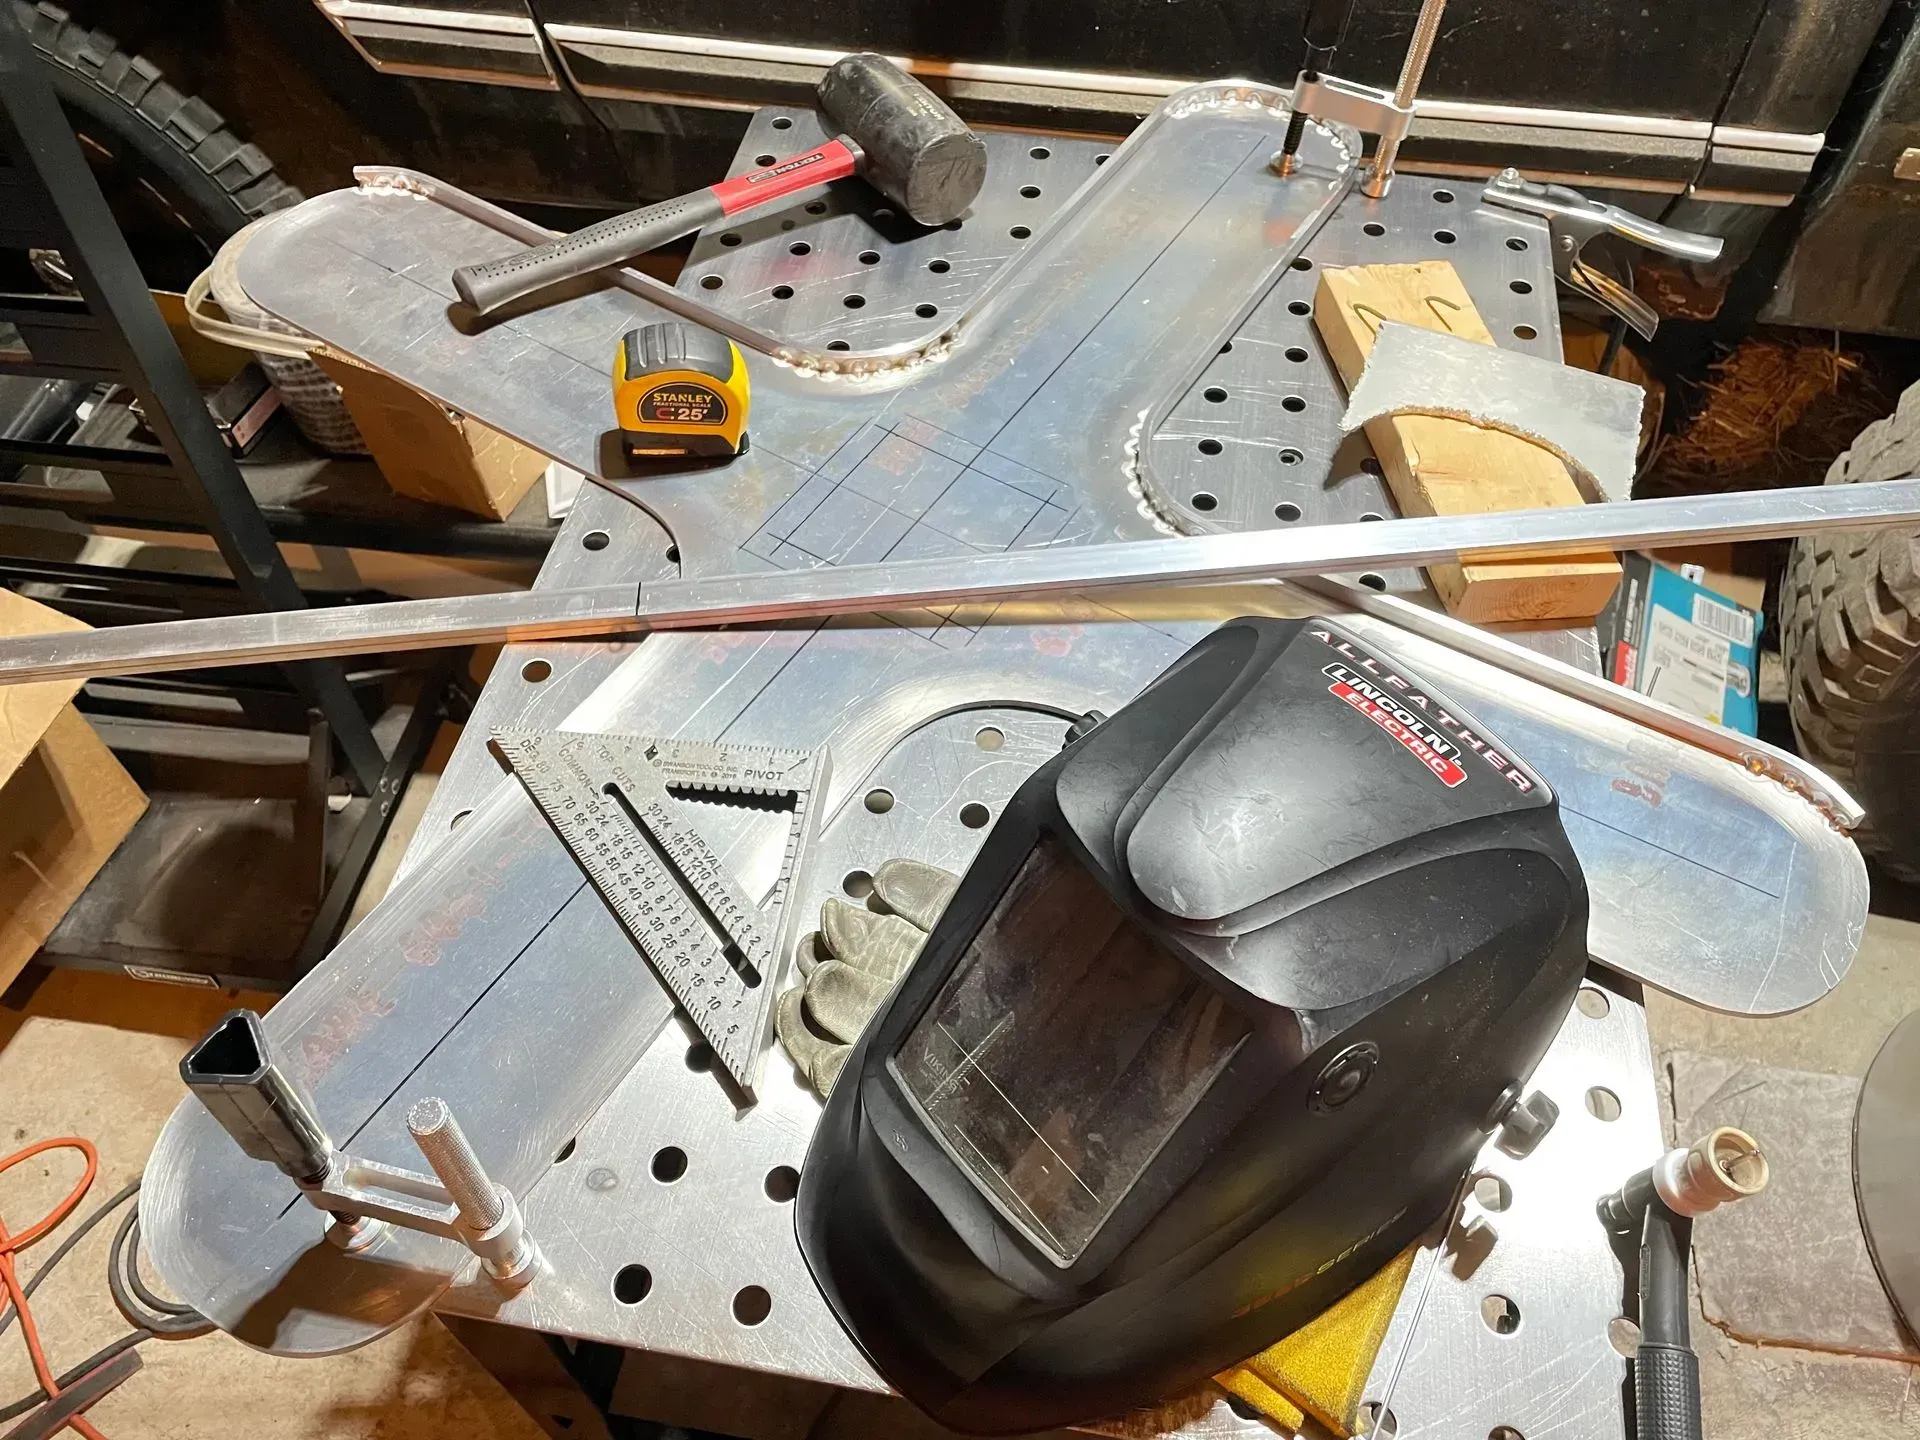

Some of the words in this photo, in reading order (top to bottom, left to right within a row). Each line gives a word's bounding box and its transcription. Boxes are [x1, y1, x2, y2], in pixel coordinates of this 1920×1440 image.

[653, 393, 712, 403] STANLEY
[678, 408, 708, 420] 25'
[1310, 629, 1538, 793] ALLFATHER
[1331, 668, 1452, 756] LINCOLN
[1344, 692, 1448, 773] ELECTRIC
[719, 753, 728, 762] 2
[558, 748, 592, 788] COMMON
[596, 744, 614, 762] TOP
[612, 766, 636, 792] CUTS
[744, 769, 784, 781] PIVOT
[648, 803, 663, 816] 30
[657, 815, 672, 829] 24
[671, 832, 685, 846] 18
[681, 843, 694, 856] 15
[684, 828, 722, 875] HIP-VAL
[690, 857, 704, 870] 12
[698, 867, 711, 880] 10
[520, 739, 540, 761] DEG.
[536, 760, 551, 774] 80
[549, 779, 564, 792] 75
[562, 796, 576, 810] 70
[573, 812, 588, 826] 65
[585, 827, 599, 841] 60
[595, 842, 610, 856] 55
[606, 857, 621, 871] 50
[618, 873, 632, 885] 45
[628, 887, 642, 900] 40
[638, 901, 653, 915] 35
[649, 917, 664, 931] 30
[661, 933, 677, 948] 25
[674, 952, 691, 967] 20
[690, 973, 705, 987] 15
[707, 996, 721, 1010] 10
[727, 1024, 739, 1034] 5
[708, 881, 719, 890] 8
[714, 888, 725, 896] 7
[586, 801, 600, 814] 30
[595, 814, 609, 827] 24
[610, 834, 624, 847] 18
[619, 847, 633, 860] 15
[632, 863, 645, 877] 12
[641, 877, 655, 890] 10
[655, 895, 666, 904] 8
[662, 904, 673, 912] 7
[670, 916, 681, 925] 6
[679, 928, 690, 937] 5
[690, 943, 700, 951] 4
[700, 958, 712, 967] 3
[714, 977, 726, 987] 2
[732, 1000, 742, 1008] 1
[719, 896, 730, 905] 6
[726, 905, 737, 914] 5
[734, 915, 744, 923] 4
[742, 924, 752, 934] 3
[750, 936, 761, 946] 2
[761, 950, 771, 958] 1
